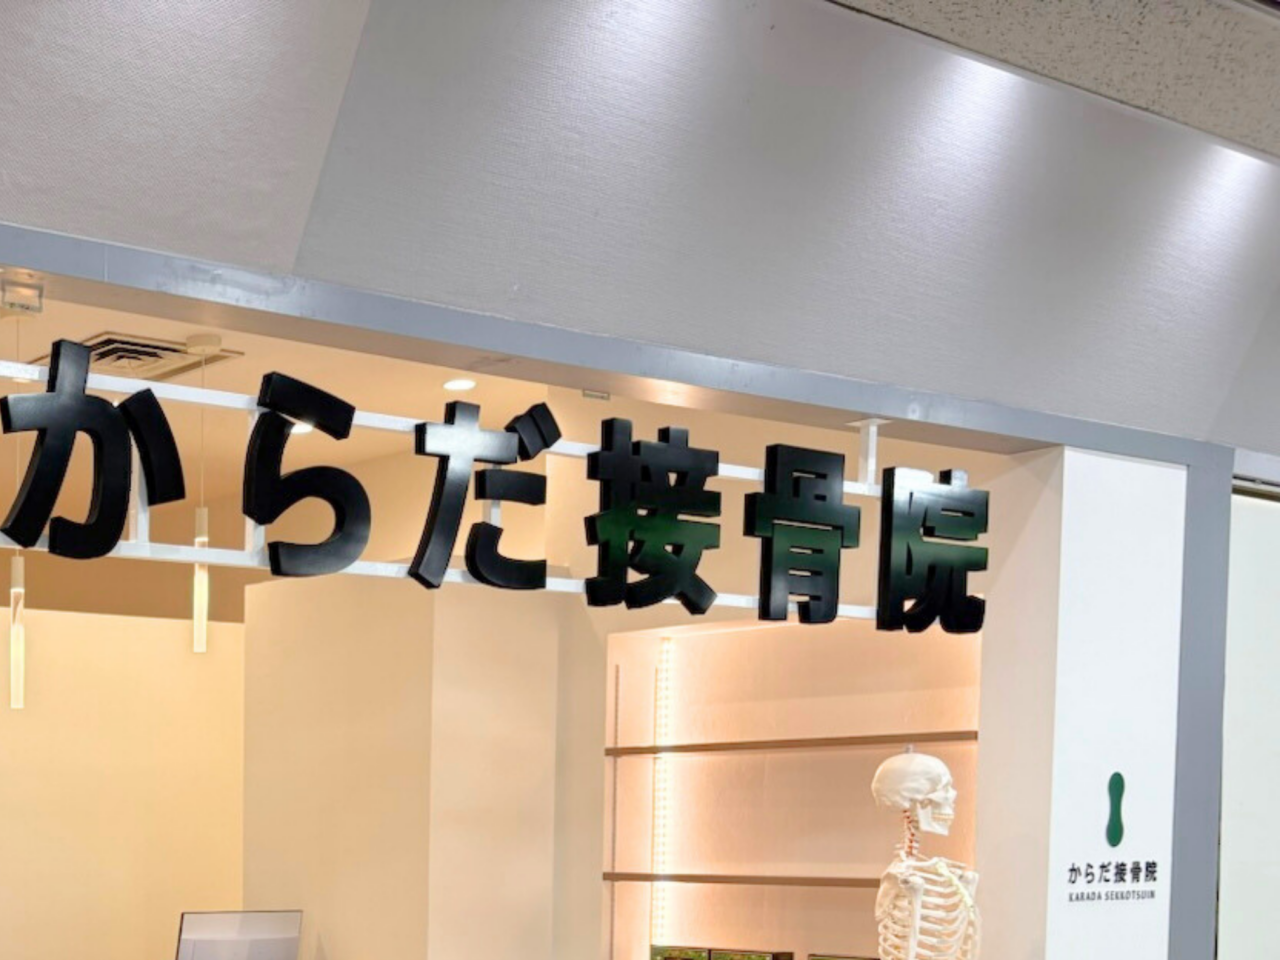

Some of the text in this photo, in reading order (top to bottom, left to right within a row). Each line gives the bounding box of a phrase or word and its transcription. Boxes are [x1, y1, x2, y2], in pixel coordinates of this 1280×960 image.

[1068, 860, 1158, 884] からだ接骨院
[1069, 891, 1102, 902] KARADA
